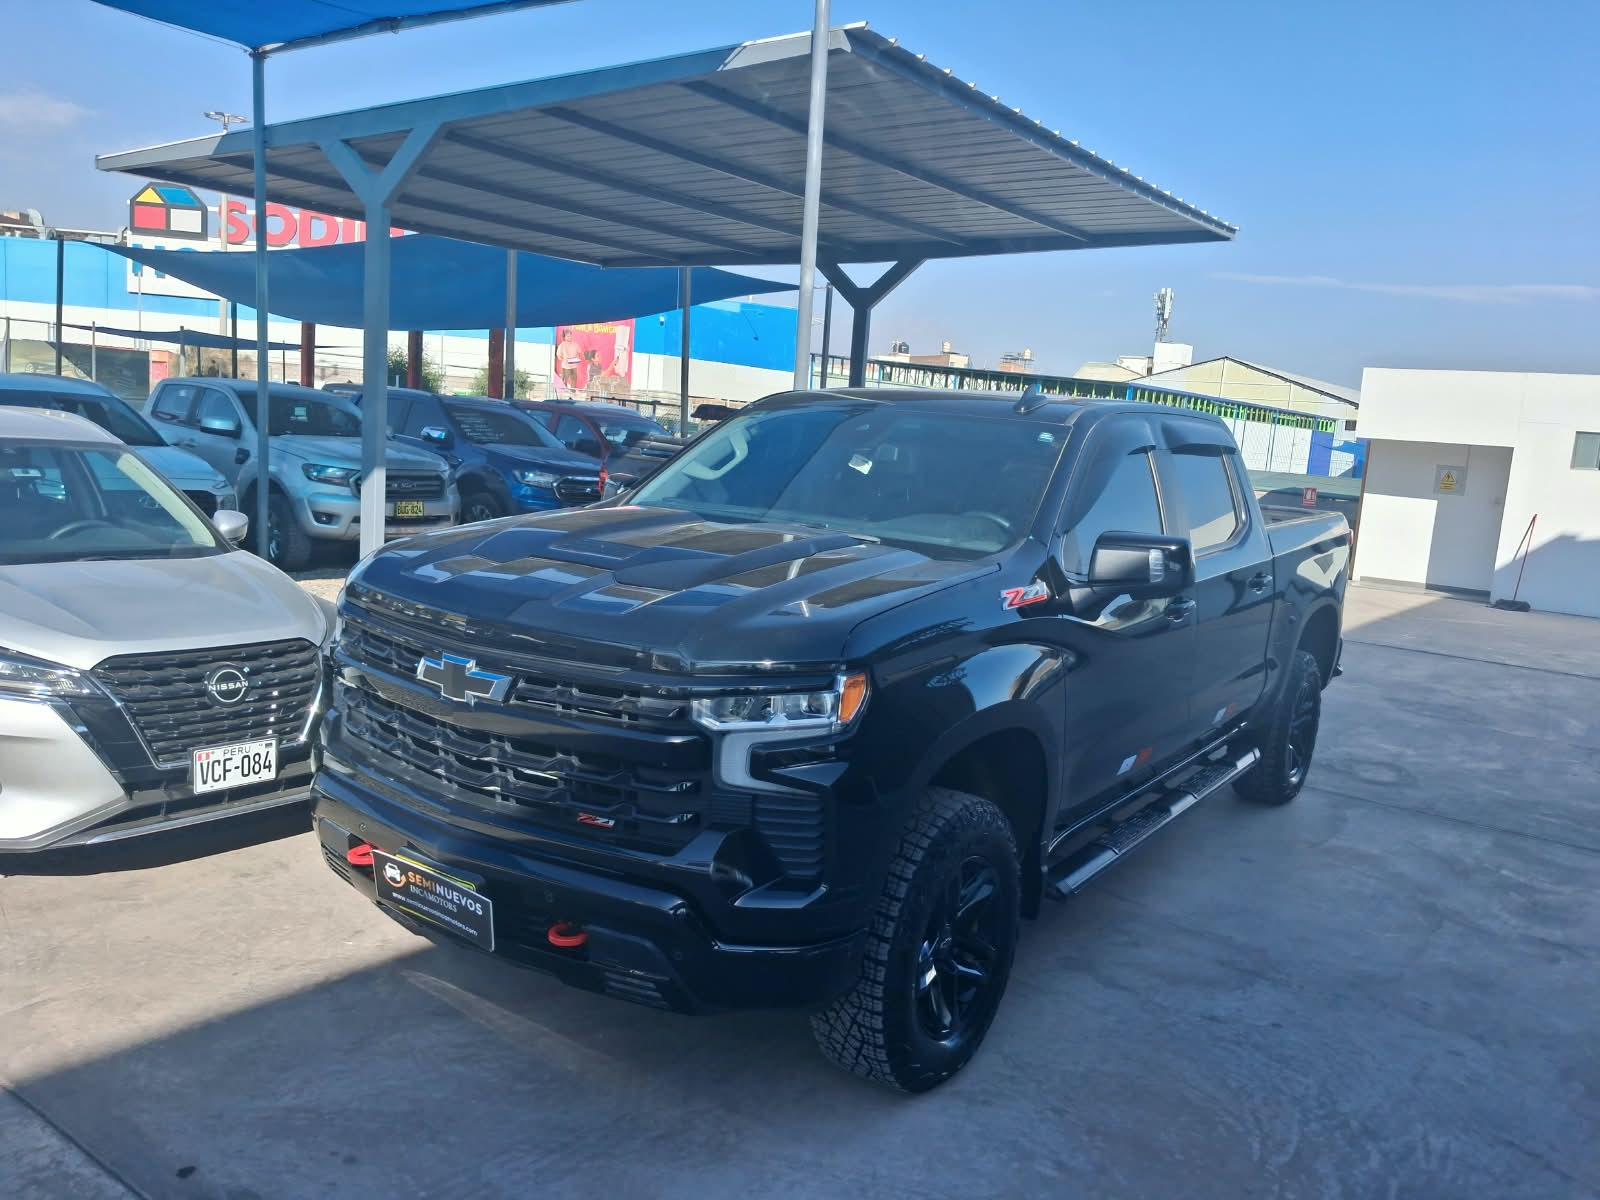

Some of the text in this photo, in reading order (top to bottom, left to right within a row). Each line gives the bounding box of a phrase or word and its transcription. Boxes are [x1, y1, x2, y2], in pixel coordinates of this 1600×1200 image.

[208, 680, 249, 692] NISSAN
[223, 746, 251, 757] PERU
[200, 751, 272, 785] VCF-084
[407, 871, 483, 916] SEMINUEVOS
[410, 885, 457, 912] INCAMOTORS
